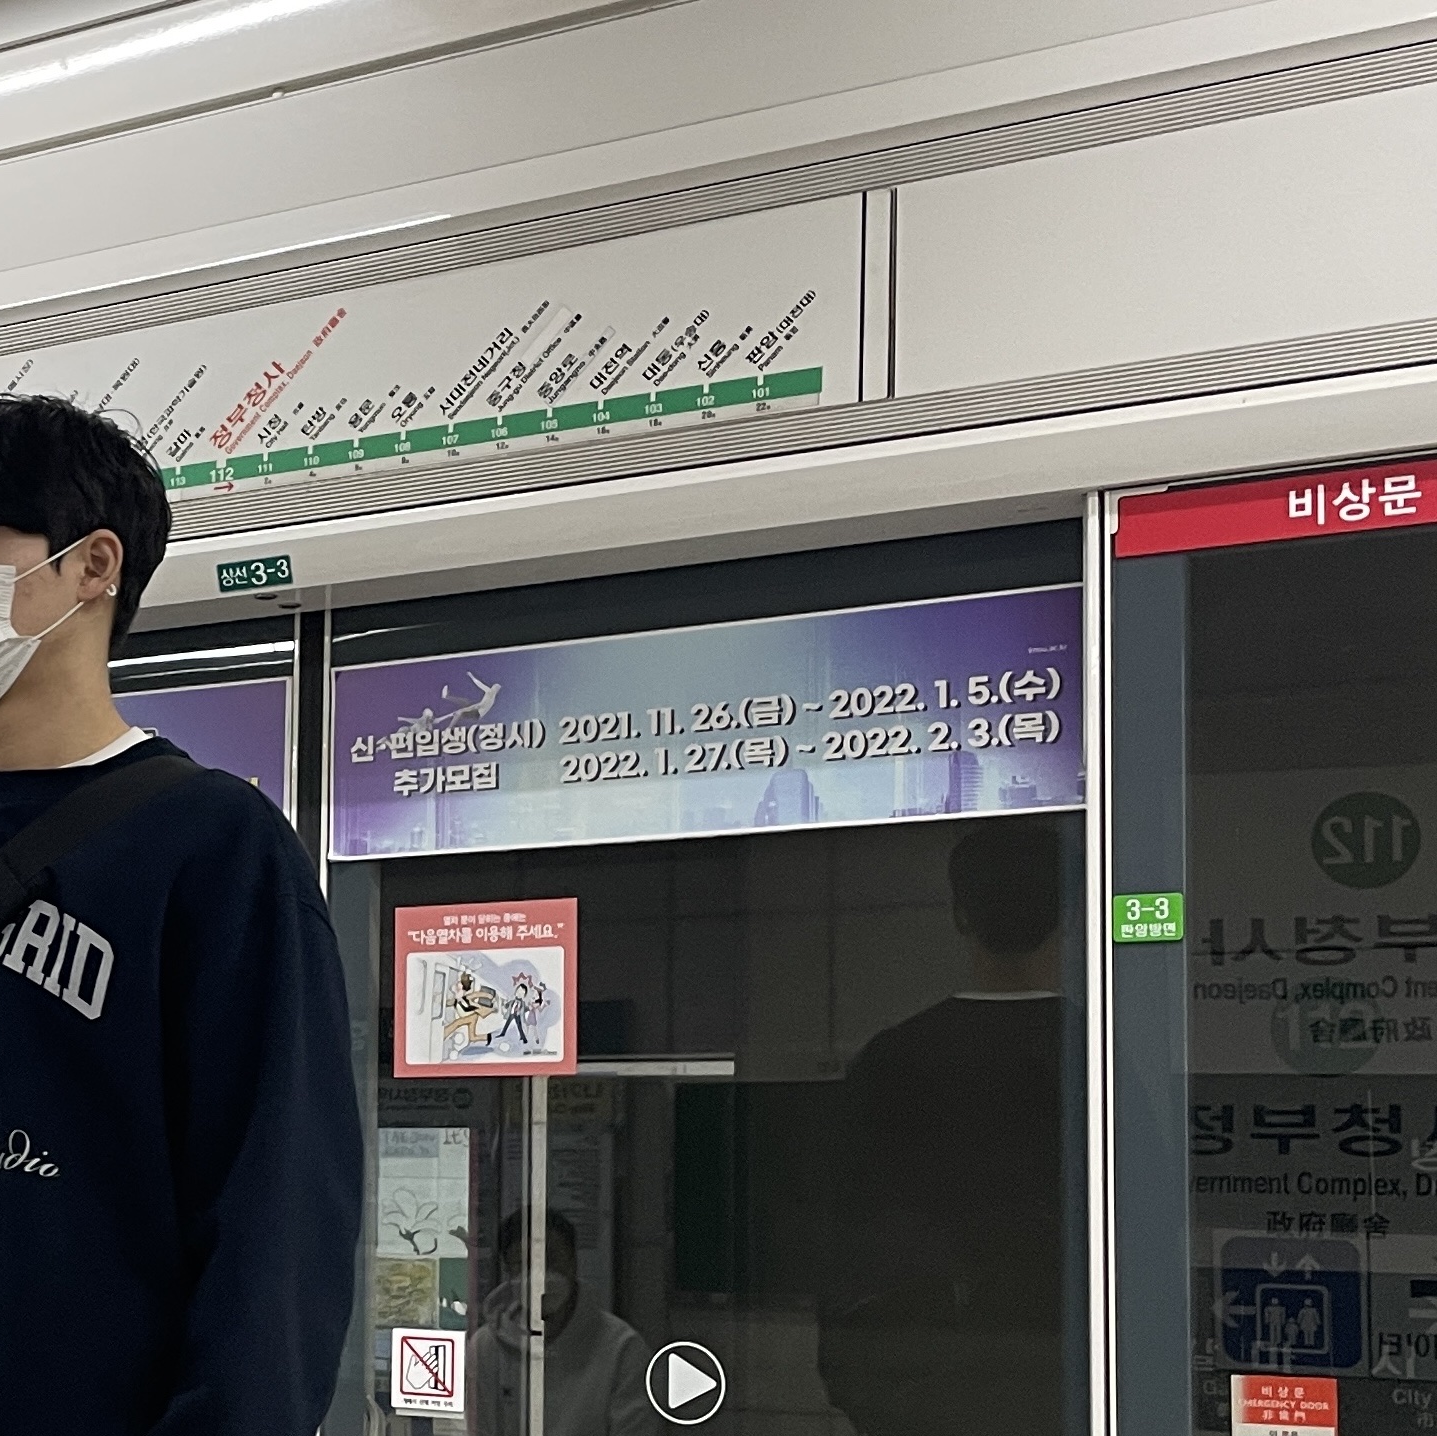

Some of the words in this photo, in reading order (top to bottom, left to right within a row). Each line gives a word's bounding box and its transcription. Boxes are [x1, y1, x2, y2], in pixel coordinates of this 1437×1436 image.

[589, 342, 632, 390] 대전역
[751, 387, 771, 399] 101
[210, 361, 285, 450] 정부청사
[696, 395, 716, 407] 102
[644, 403, 663, 415] 103
[592, 411, 610, 423] 104
[441, 434, 460, 446] 107
[258, 463, 273, 473] 111
[303, 456, 321, 467] 110
[209, 467, 235, 482] 112
[1288, 474, 1422, 525] 비상문
[250, 559, 289, 585] 3-3
[558, 711, 641, 745] 2021.
[647, 706, 685, 736] 11.
[690, 693, 796, 733] 26.(금)
[829, 683, 927, 719] 2022.
[934, 680, 961, 709] 1.
[967, 667, 1061, 704] 5.(수)
[393, 761, 499, 797] 추가모집
[560, 750, 648, 784] 2022.
[654, 747, 679, 775] 1.
[684, 735, 788, 773] 27.(목)
[822, 725, 921, 761] 2022.
[927, 721, 960, 752] 2.
[967, 710, 1061, 748] 3.(목)
[1126, 897, 1169, 921] 3-3
[476, 925, 513, 942] 이용해
[1300, 1401, 1329, 1410] DOOR
